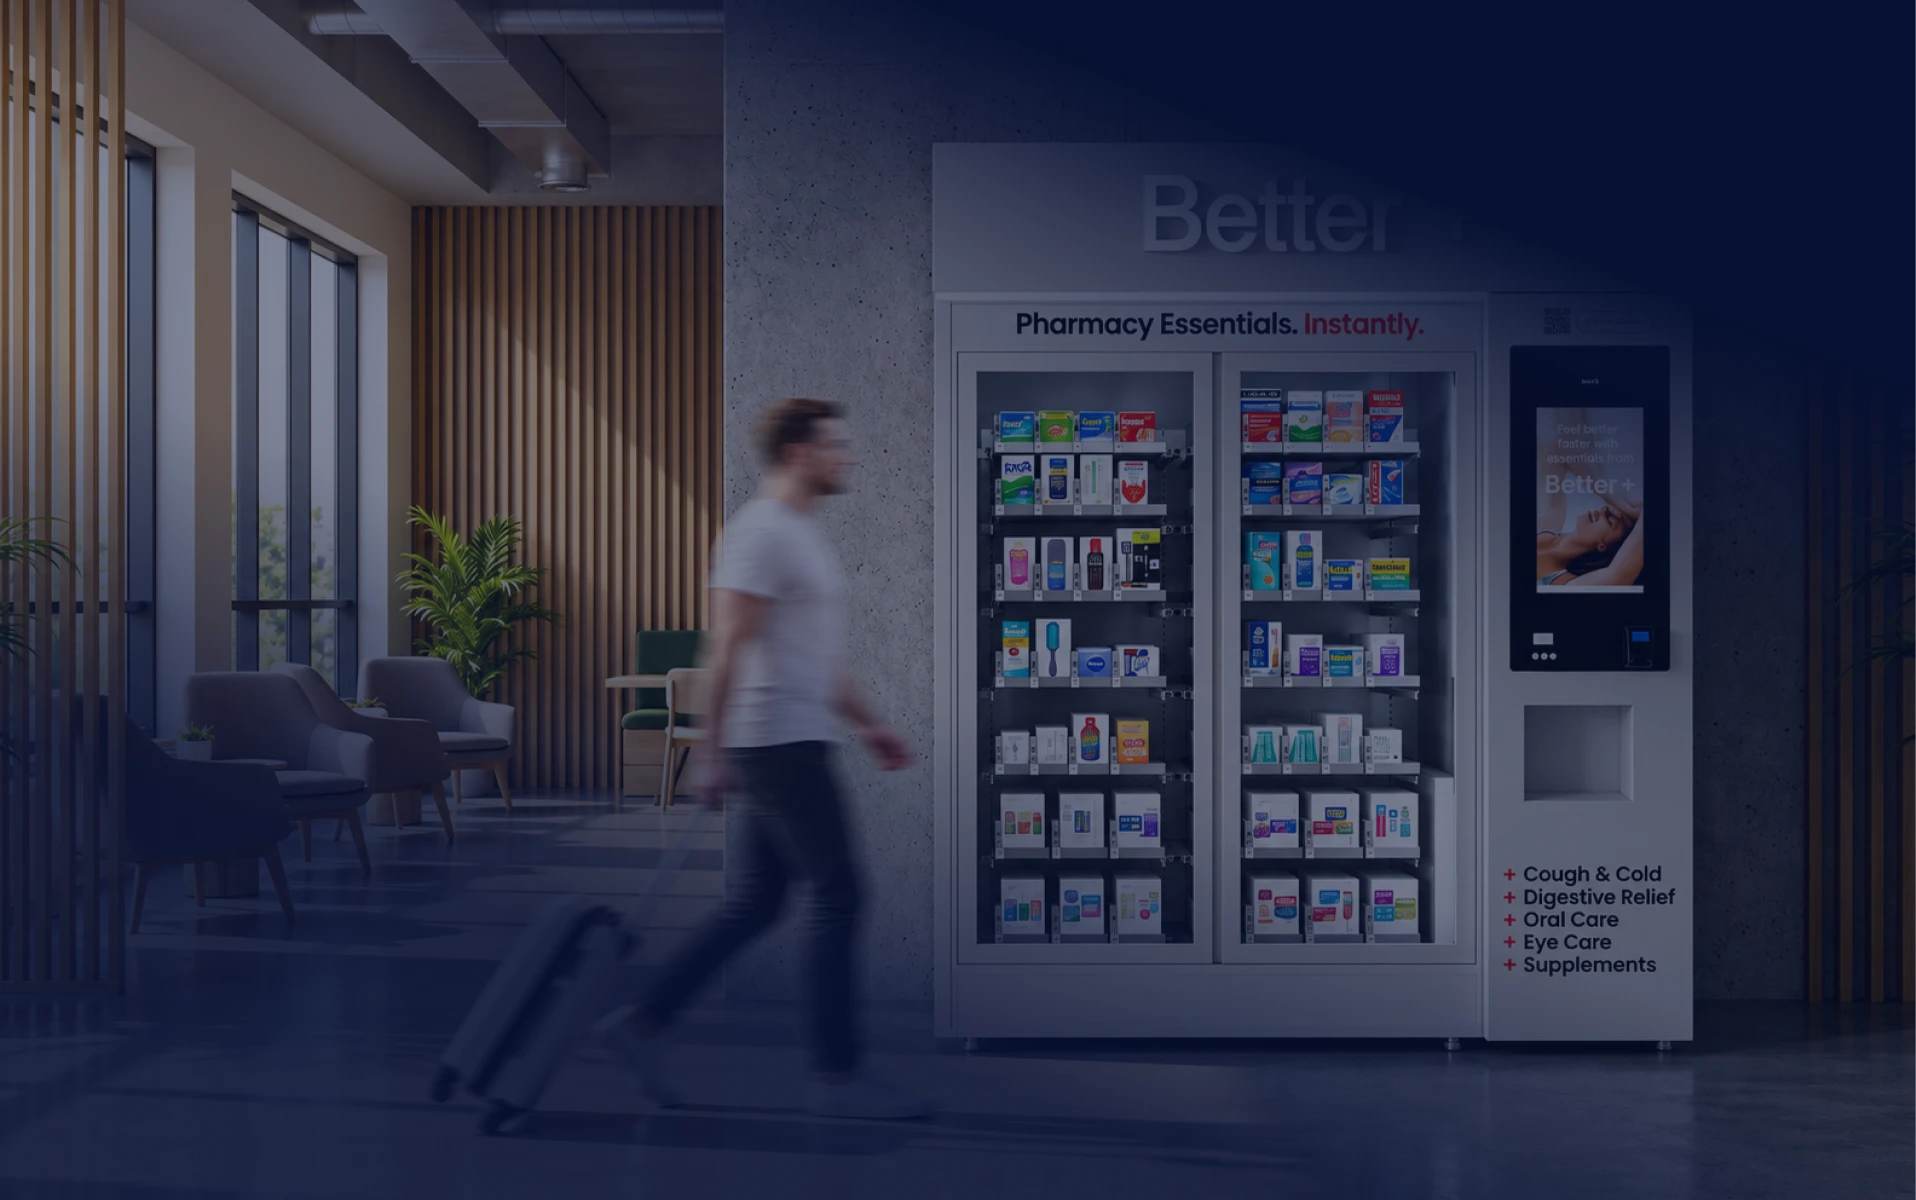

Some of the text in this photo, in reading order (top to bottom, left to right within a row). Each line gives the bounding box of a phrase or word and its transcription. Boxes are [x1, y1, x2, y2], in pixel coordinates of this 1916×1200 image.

[1142, 174, 1403, 252] Better
[1016, 312, 1425, 341] Pharmacy Essentials. Instantly.
[1557, 423, 1619, 434] Feel better
[1557, 438, 1619, 449] faster with
[1546, 452, 1635, 464] essentials from
[1545, 474, 1618, 494] Better
[1524, 865, 1590, 886] Cough
[1595, 866, 1610, 882] &
[1616, 865, 1662, 882] Cold
[1524, 888, 1616, 910] Digestive
[1621, 888, 1676, 905] Relief
[1524, 911, 1565, 927] Oral
[1570, 912, 1619, 927] Care
[1524, 934, 1559, 954] Eye
[1564, 934, 1612, 950] Care
[1524, 956, 1657, 977] Supplements
